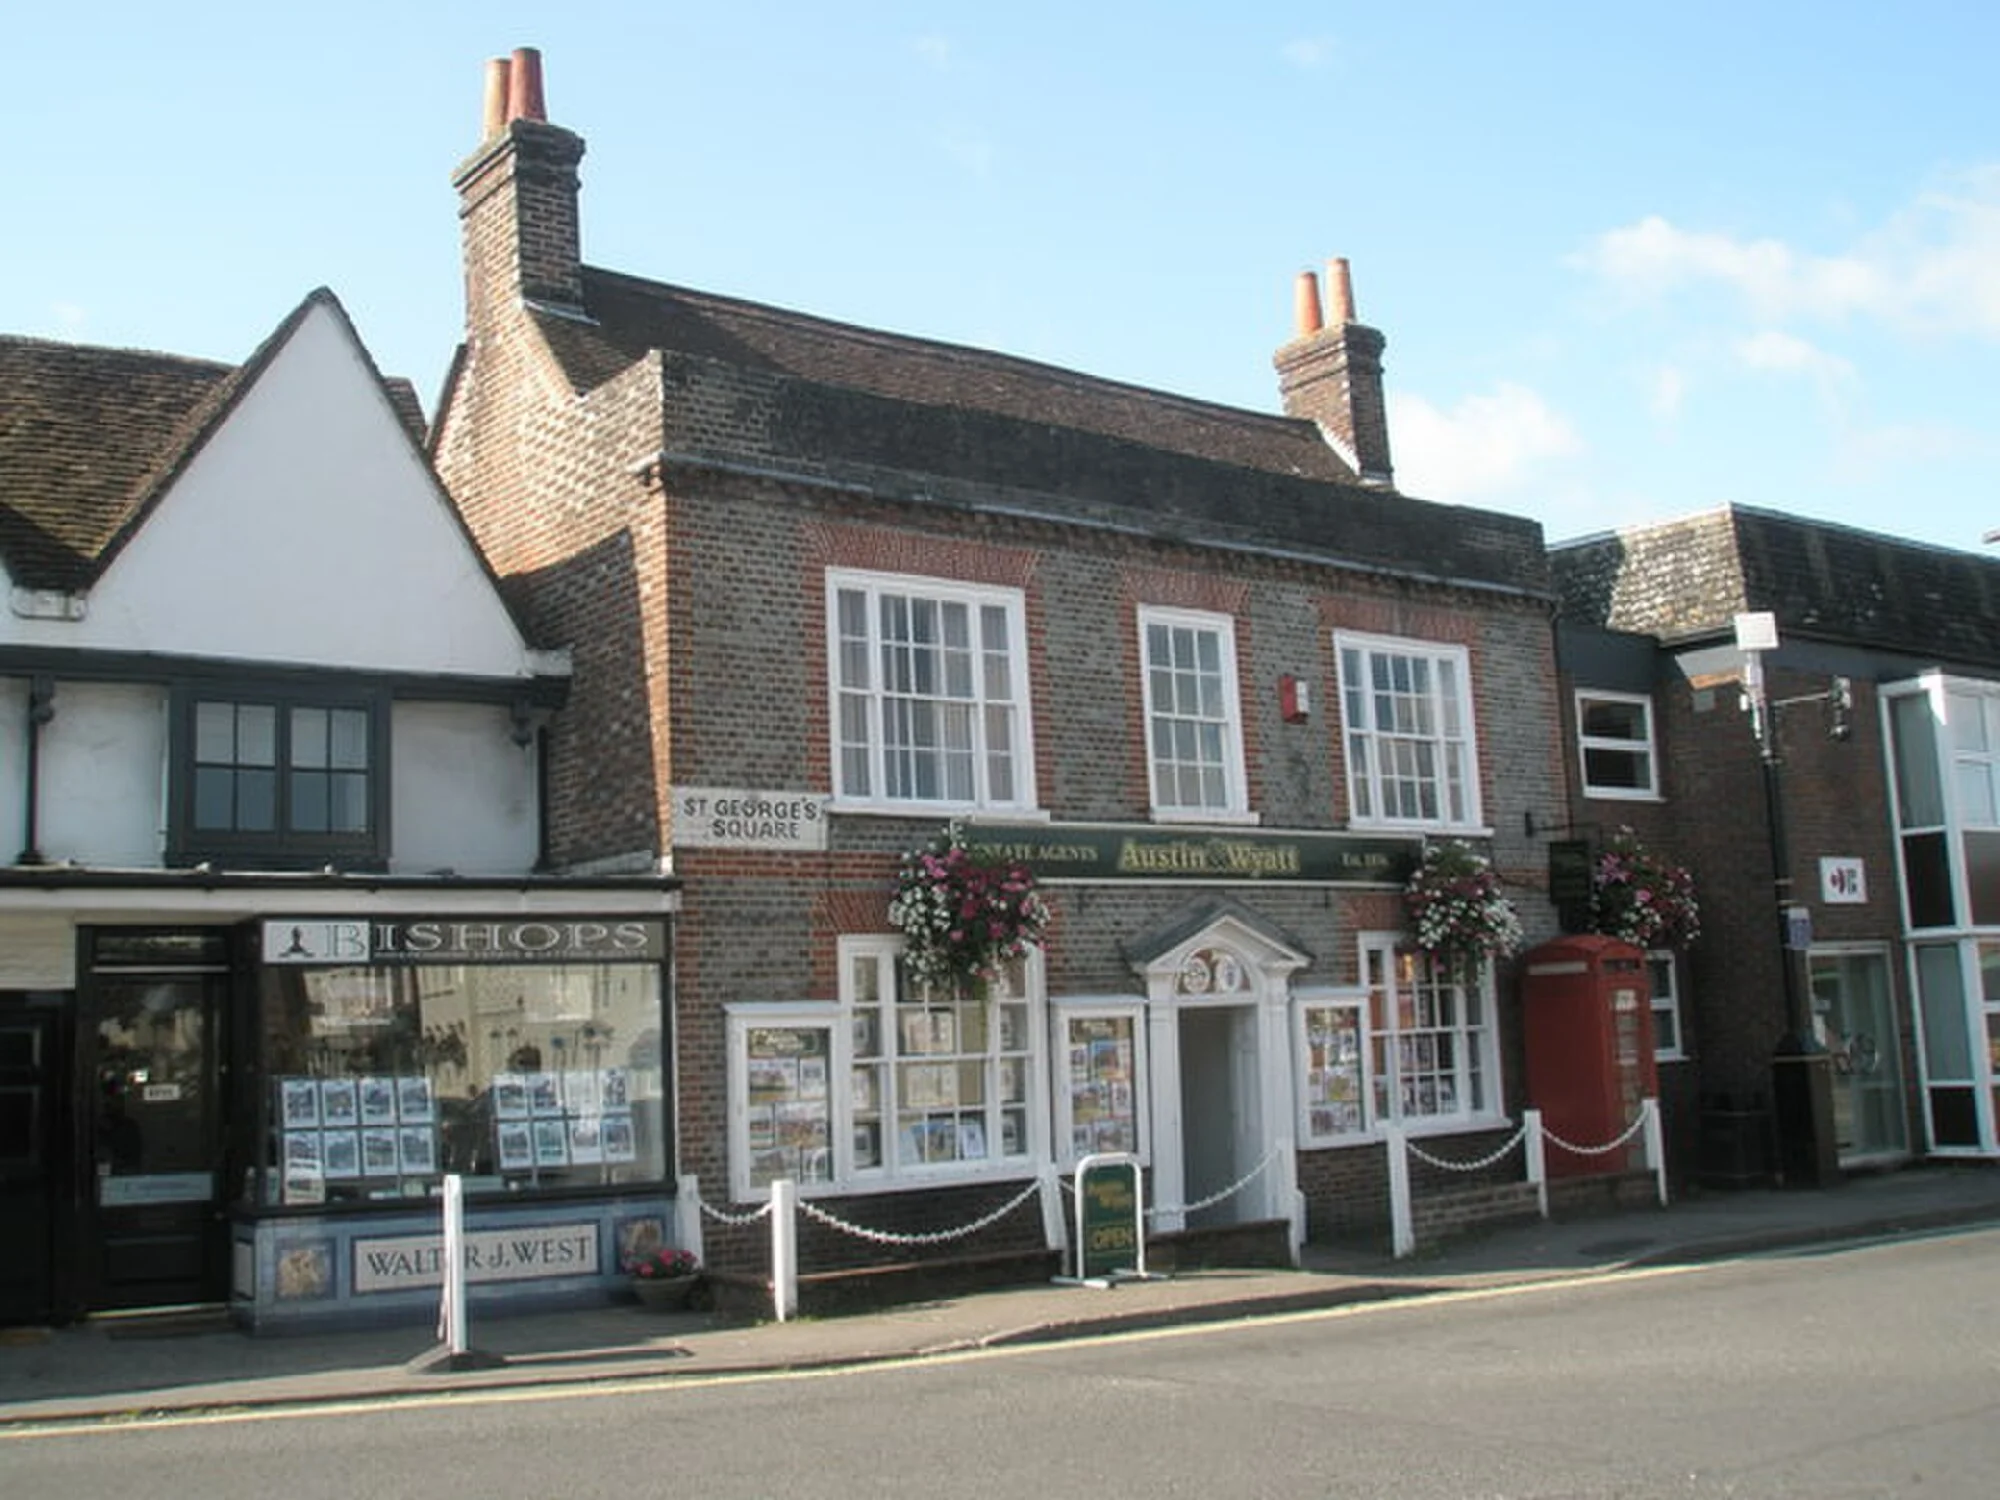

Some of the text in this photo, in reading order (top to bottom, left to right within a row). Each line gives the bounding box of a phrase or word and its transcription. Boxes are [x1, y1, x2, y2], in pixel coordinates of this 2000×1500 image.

[683, 796, 818, 821] ST GEORGE'S
[711, 819, 801, 840] SQUARE
[1119, 838, 1205, 871] Austin
[1226, 842, 1300, 878] Wyatt
[324, 921, 651, 958] BISHOPS
[1090, 1227, 1135, 1251] OPEN
[366, 1244, 482, 1278] WALTR
